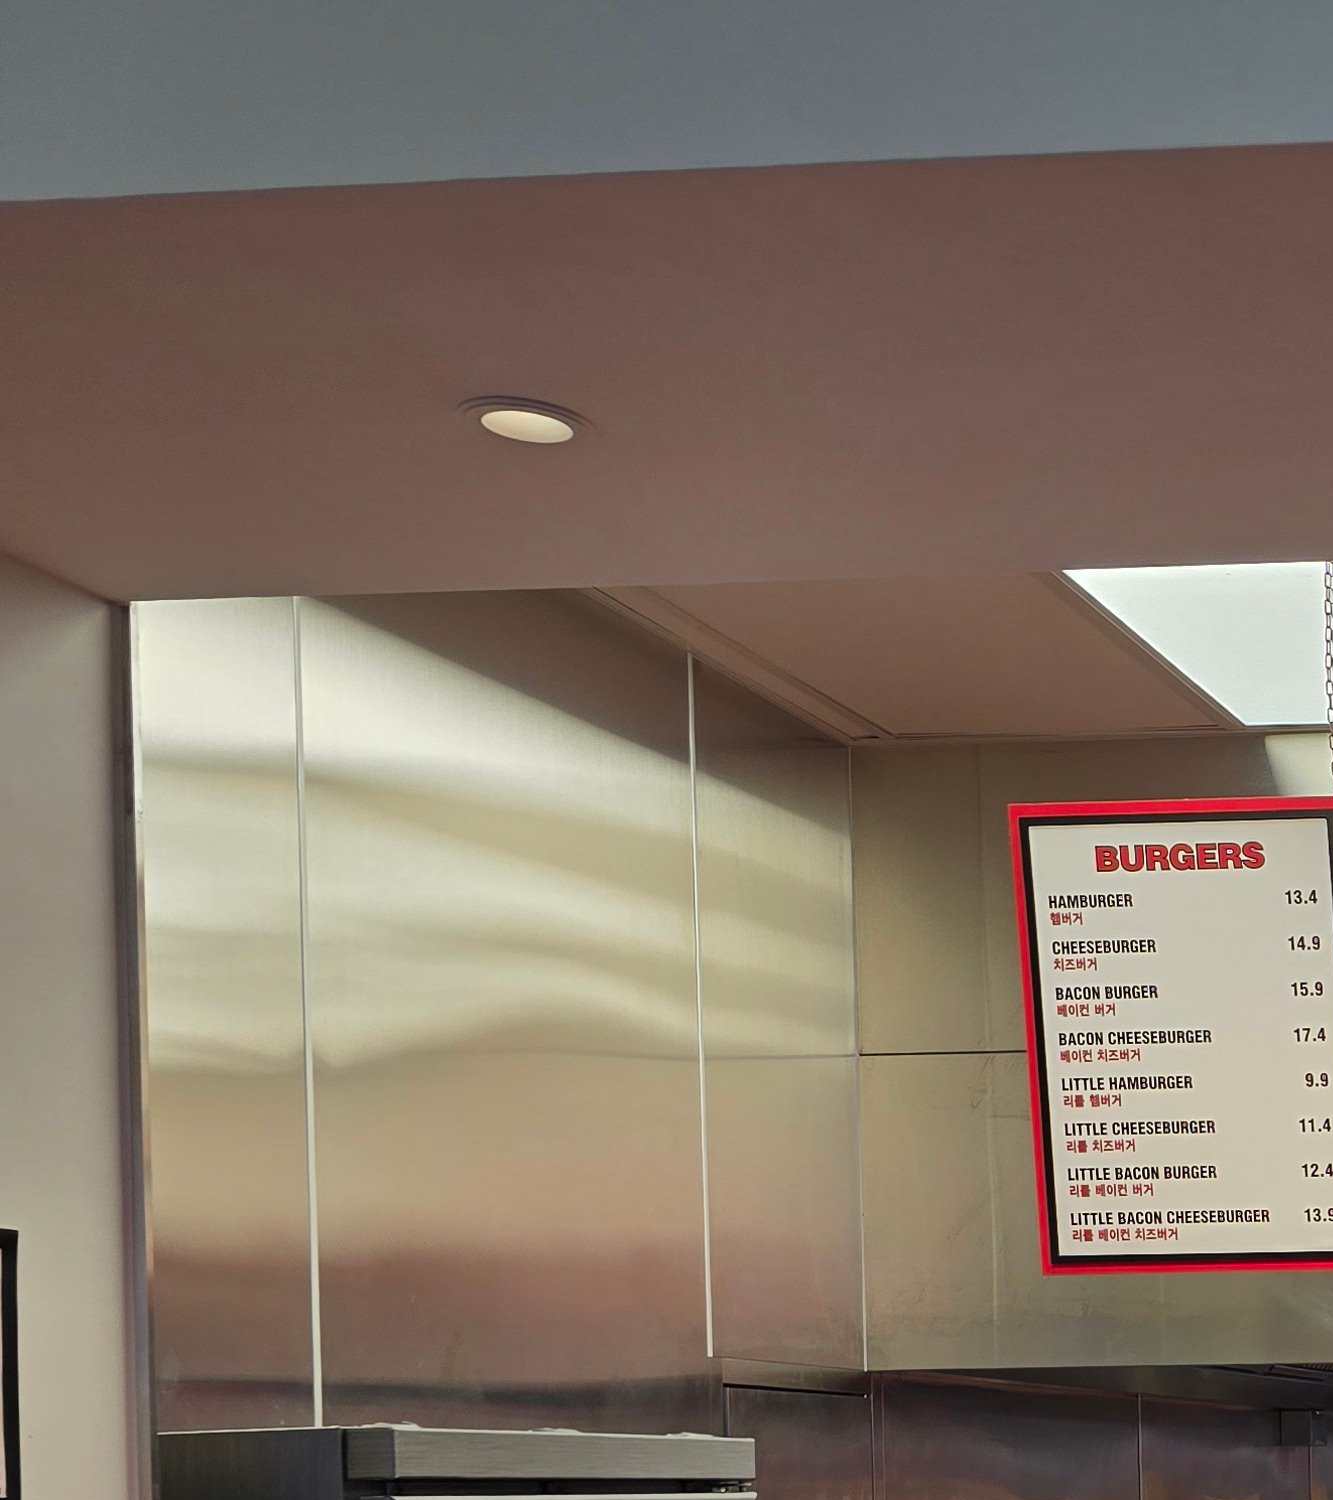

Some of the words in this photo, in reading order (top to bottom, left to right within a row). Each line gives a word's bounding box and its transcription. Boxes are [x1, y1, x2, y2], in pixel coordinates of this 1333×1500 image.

[1094, 841, 1267, 873] BURGERS
[1048, 893, 1133, 909] HAMBURGER
[1284, 889, 1317, 904] 13.4
[1052, 939, 1156, 955] CHEESEBURGER
[1287, 935, 1320, 950] 14.9
[1053, 956, 1097, 971] 치즈버거
[1055, 986, 1100, 1000] BACON
[1104, 985, 1158, 999] BURGER
[1290, 981, 1323, 996] 15.9
[1056, 1003, 1090, 1017] 베이컨
[1094, 1002, 1115, 1017] 버거
[1058, 1031, 1103, 1046] BACON
[1107, 1029, 1212, 1045] CHEESEBURGER
[1293, 1027, 1326, 1042] 17.4
